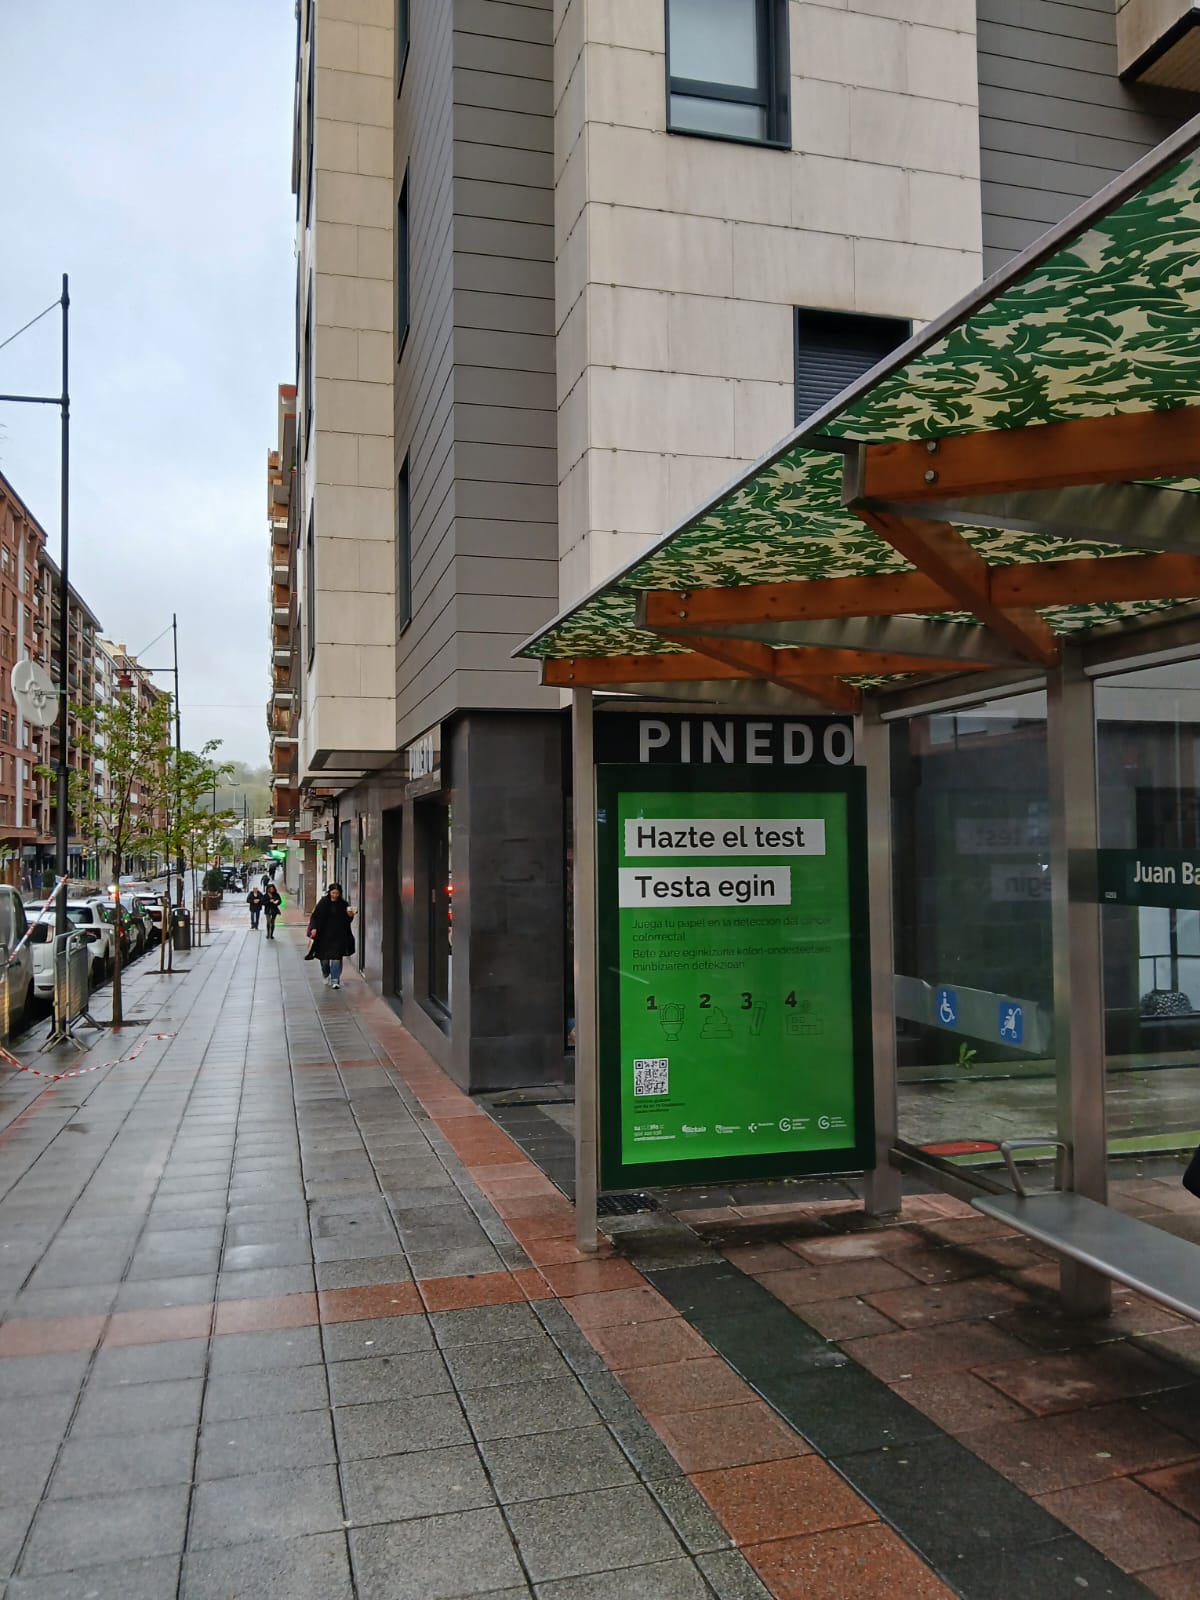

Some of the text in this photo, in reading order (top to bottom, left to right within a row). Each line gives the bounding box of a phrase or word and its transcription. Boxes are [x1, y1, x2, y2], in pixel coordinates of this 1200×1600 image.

[639, 720, 854, 766] PINEDO
[637, 825, 806, 849] Hazte el test
[1133, 860, 1200, 886] Juan Ba
[634, 874, 775, 902] Testa egin
[632, 919, 663, 931] Juega
[664, 918, 675, 928] tu
[677, 917, 706, 929] papel
[646, 995, 658, 1010] 1
[699, 994, 712, 1009] 2
[740, 992, 753, 1010] 3
[785, 991, 797, 1008] 4
